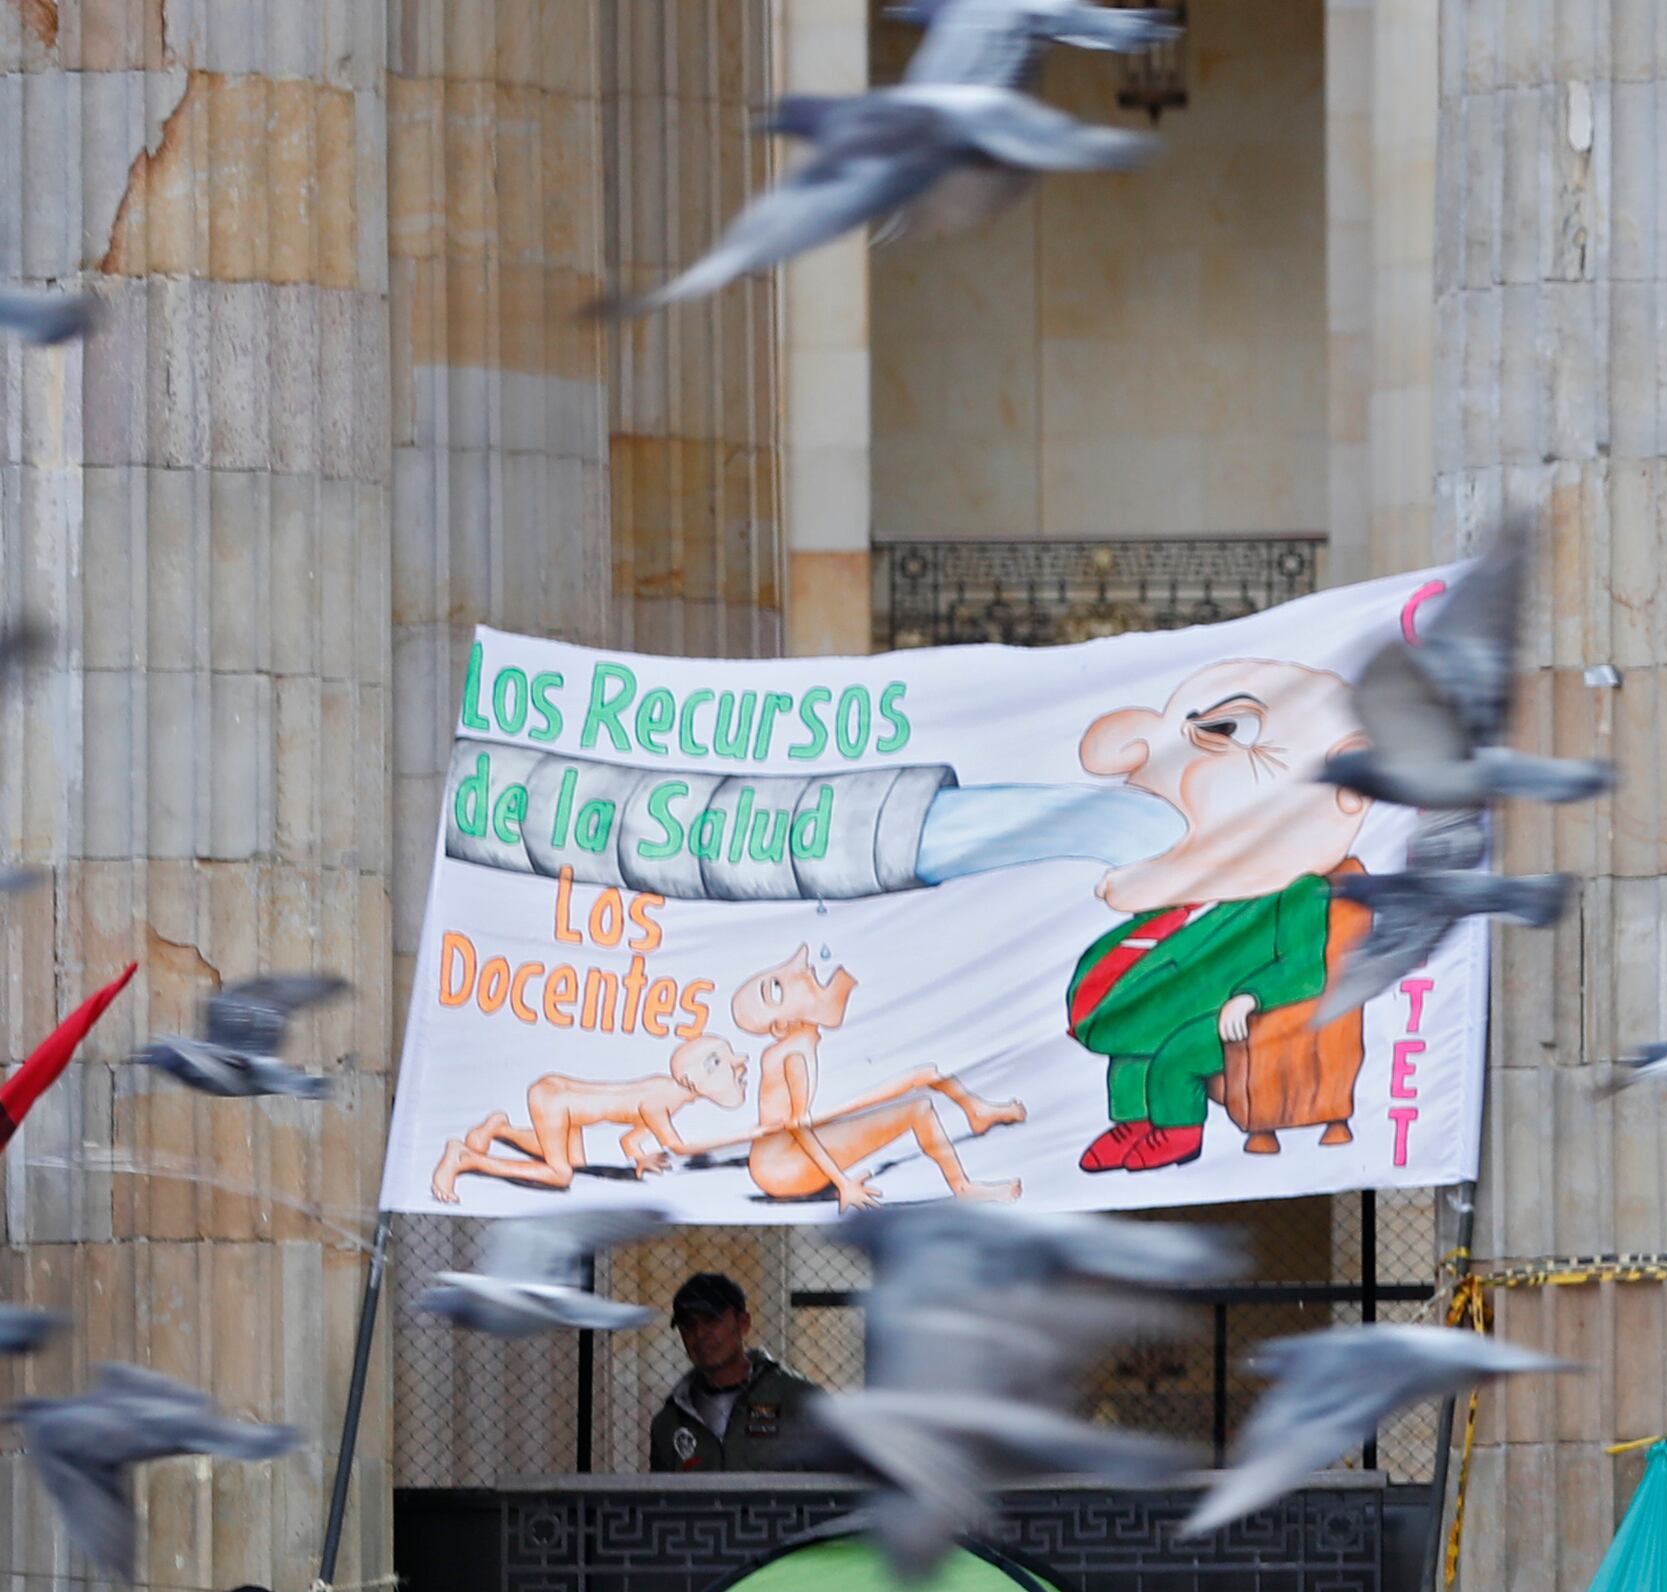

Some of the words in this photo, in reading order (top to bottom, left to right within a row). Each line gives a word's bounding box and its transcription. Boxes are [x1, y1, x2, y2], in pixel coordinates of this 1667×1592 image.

[463, 641, 564, 742] Los
[580, 663, 912, 763] Recursos
[455, 769, 529, 845] de
[550, 779, 616, 855] la
[638, 780, 834, 866] Salud
[554, 865, 666, 953] Los
[440, 932, 714, 1037] Docentes
